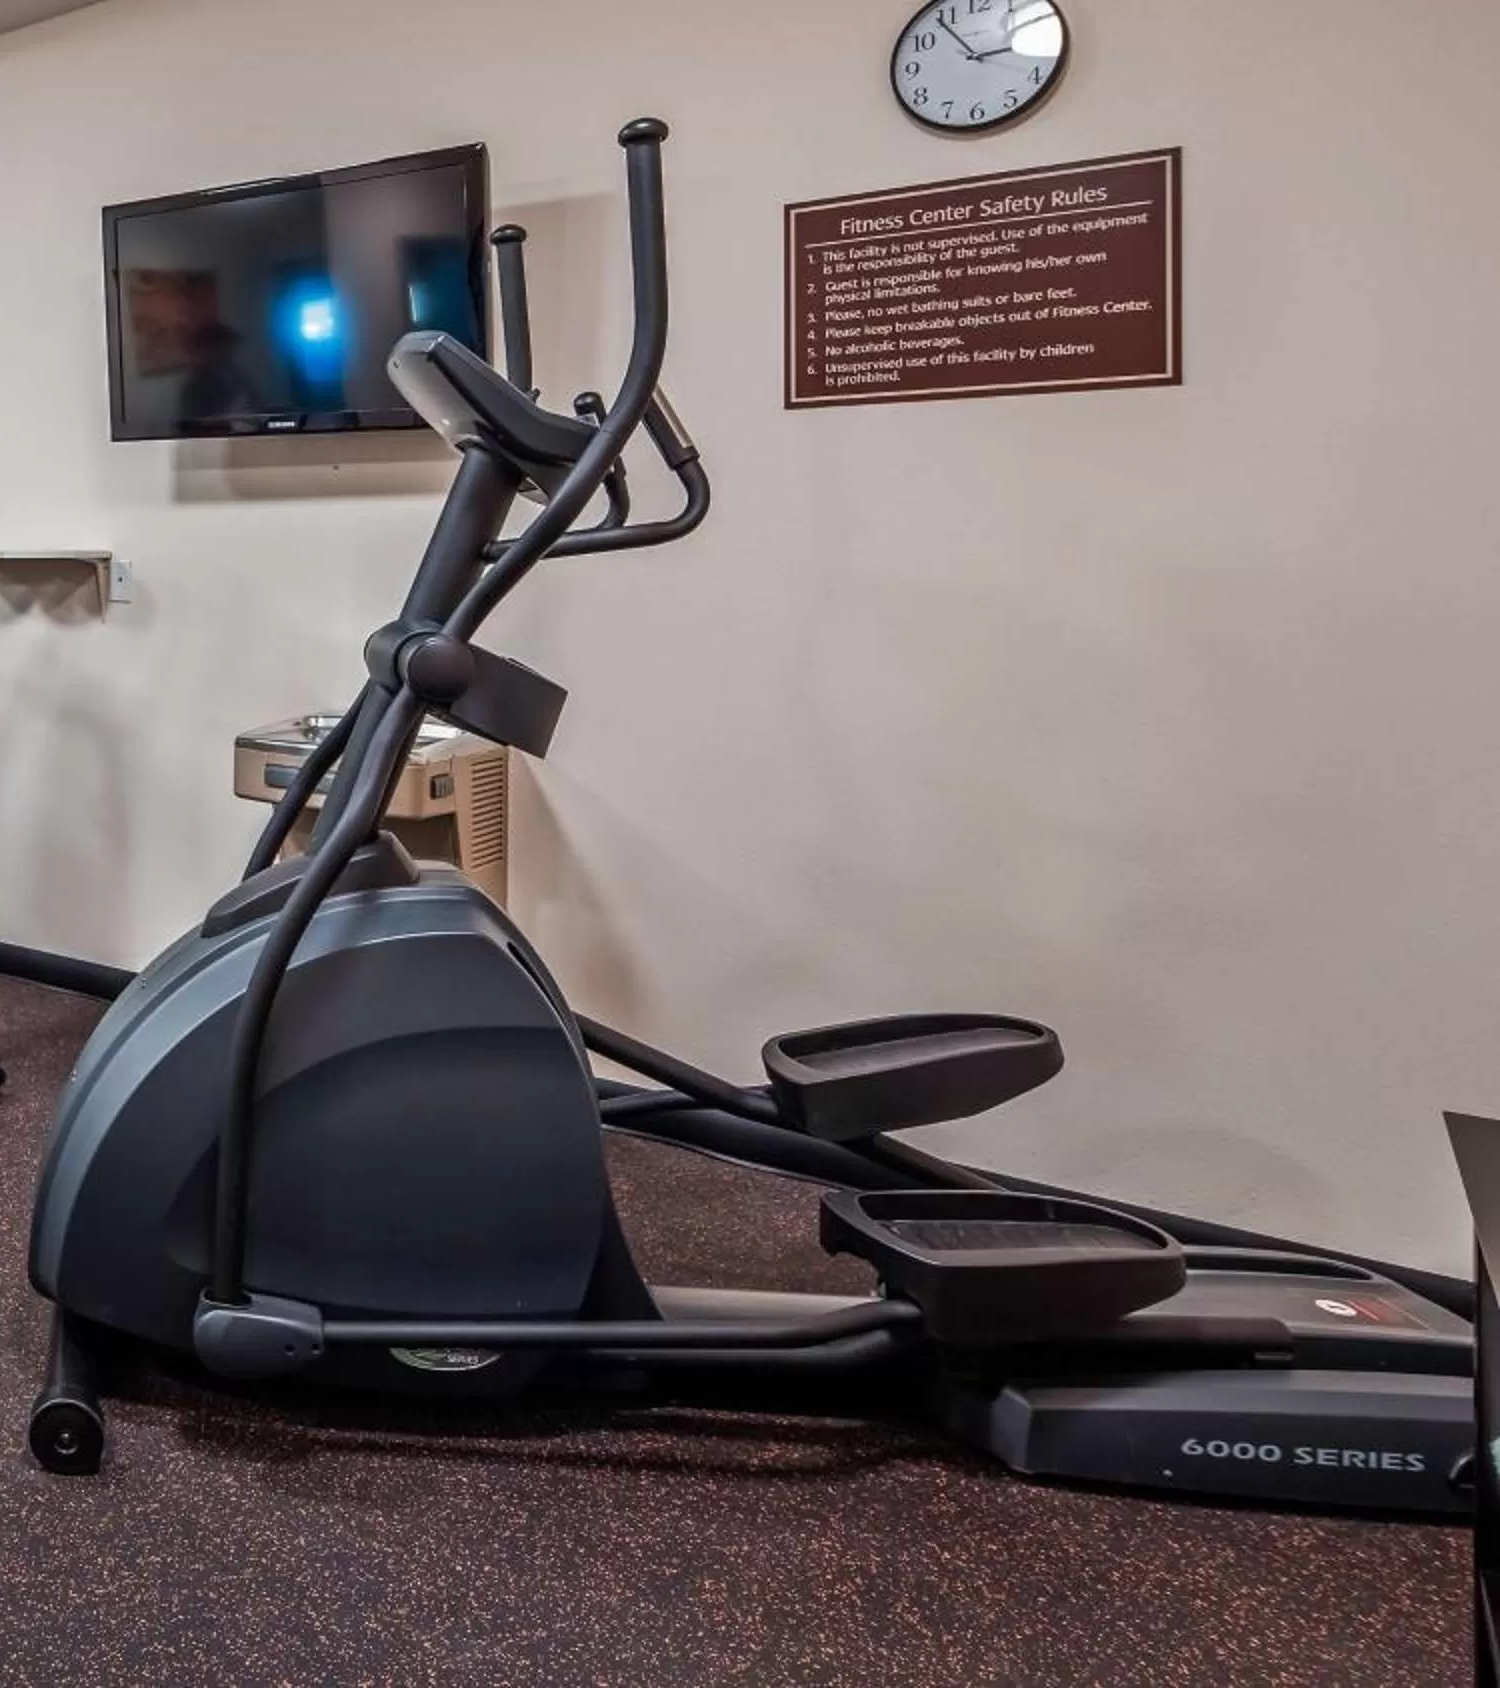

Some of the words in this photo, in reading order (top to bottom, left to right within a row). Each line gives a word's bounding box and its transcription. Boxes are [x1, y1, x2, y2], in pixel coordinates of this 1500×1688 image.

[914, 31, 935, 52] 10
[905, 61, 920, 81] 9
[1027, 65, 1043, 85] 4
[913, 86, 928, 106] 8
[1003, 89, 1018, 109] 5
[941, 101, 954, 119] 7
[970, 101, 985, 121] 6
[840, 215, 904, 235] Fitness
[909, 205, 974, 225] Center
[979, 194, 1046, 217] Safety
[1051, 186, 1108, 207] Rules
[822, 251, 846, 262] This
[850, 245, 887, 259] facility
[891, 243, 900, 254] is
[903, 240, 925, 252] not
[928, 231, 999, 248] supervised.
[1002, 228, 1026, 241] Use
[1029, 223, 1044, 237] of
[1047, 222, 1069, 235] the
[1072, 212, 1148, 232] equipment
[823, 263, 833, 275] is
[835, 261, 855, 273] the
[857, 252, 937, 271] responsibility
[939, 247, 952, 260] of
[956, 246, 977, 259] the
[980, 243, 1020, 259] guest.
[825, 279, 858, 292] Guest
[861, 277, 871, 287] is
[873, 270, 942, 286] responsible
[945, 267, 964, 278] for
[967, 260, 1023, 276] knowing
[1025, 254, 1073, 270] his/her
[1075, 251, 1107, 264] own
[825, 290, 871, 306] physical
[873, 284, 941, 299] limitations.
[868, 307, 883, 317] no
[886, 303, 910, 315] wet
[911, 299, 959, 314] bathing
[962, 295, 992, 309] suits
[995, 294, 1010, 305] or
[1013, 291, 1043, 303] bare
[1047, 287, 1077, 300] feet.
[825, 327, 862, 339] Please
[864, 324, 893, 337] keep
[895, 317, 955, 333] breakable
[958, 311, 1006, 328] objects
[1008, 310, 1032, 323] out
[1035, 307, 1049, 320] of
[1053, 304, 1100, 318] Fitness
[1103, 300, 1153, 314] Center.
[825, 345, 842, 356] No
[845, 340, 897, 355] alcoholic
[900, 336, 965, 351] beverages.
[825, 357, 902, 374] Unsupervised
[905, 356, 928, 367] use
[930, 353, 944, 365] of
[947, 351, 970, 364] this
[973, 348, 1016, 363] facility
[1019, 347, 1036, 360] by
[1039, 343, 1095, 357] children
[825, 375, 834, 386] is
[837, 370, 901, 387] prohibited.
[1181, 1438, 1282, 1462] 6000
[1293, 1446, 1426, 1472] SERIES
